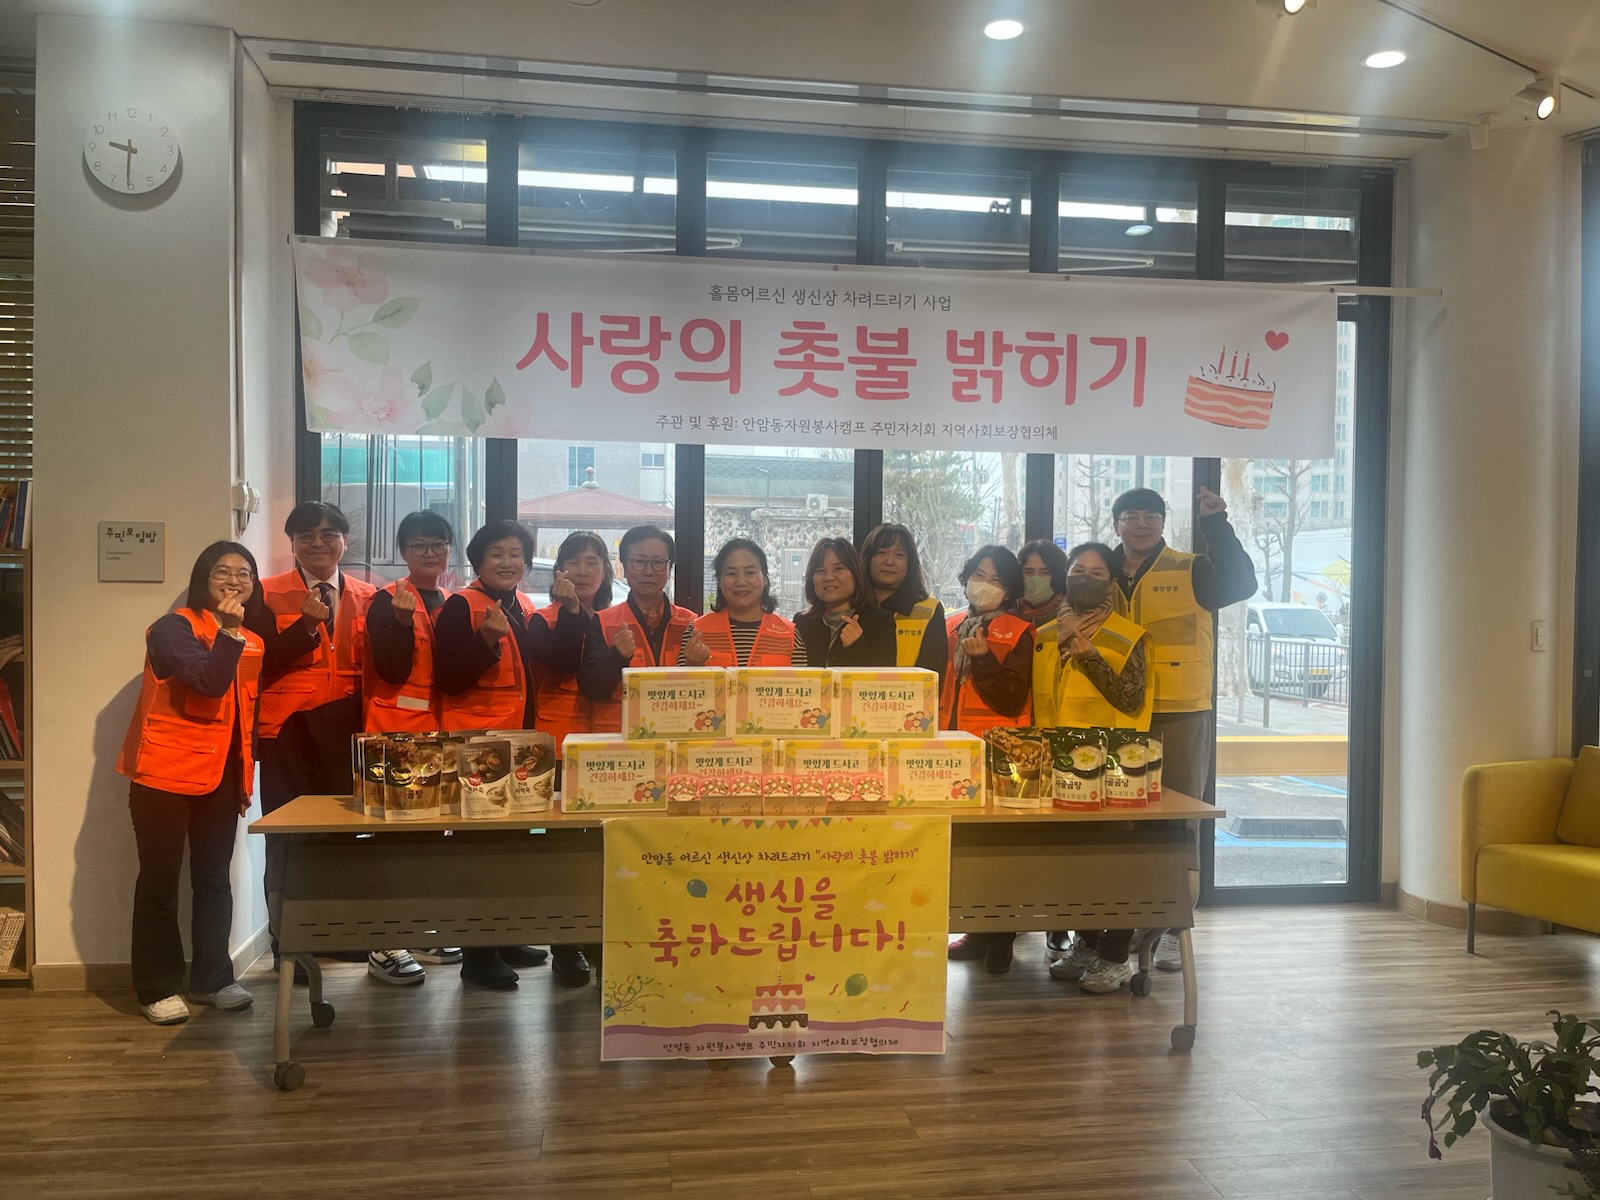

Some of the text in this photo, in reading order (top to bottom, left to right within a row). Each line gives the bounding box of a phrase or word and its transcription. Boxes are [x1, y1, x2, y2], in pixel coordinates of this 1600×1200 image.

[107, 112, 118, 122] 11
[127, 107, 137, 118] 12
[94, 125, 104, 135] 10
[160, 126, 168, 137] 2
[88, 142, 96, 152] 9
[166, 145, 174, 156] 3
[94, 161, 101, 171] 8
[160, 164, 167, 173] 4
[109, 174, 116, 184] 7
[146, 176, 154, 187] 5
[127, 180, 135, 191] 6
[708, 284, 951, 312] 홀몸어르신 생신상 차려드리기 사업
[515, 311, 1147, 408] 사랑의 촛불 밝히기
[656, 415, 1058, 441] 주관 및 후원: 안암동자원봉사캠프 주민자치회 지역사회보장협의체
[106, 527, 158, 543] 주민모임방
[648, 690, 706, 700] 맛있게 드시고
[756, 686, 812, 696] 맛있게 드시고
[859, 690, 915, 701] 맛있게 드시고
[587, 761, 646, 771] 맛있게 드시고
[695, 757, 753, 767] 맛있게 드시고
[803, 759, 860, 769] 맛있게 드시고
[906, 759, 962, 769] 맛있게 드시고
[641, 847, 919, 865] 안암동 어르신 생신상 차려드리기 "사랑의 촛불 밝히기"
[725, 876, 837, 921] 생신을
[649, 916, 906, 968] 축하드립니다!
[663, 1042, 691, 1052] 안암동
[696, 1041, 754, 1052] 자원봉사캠프
